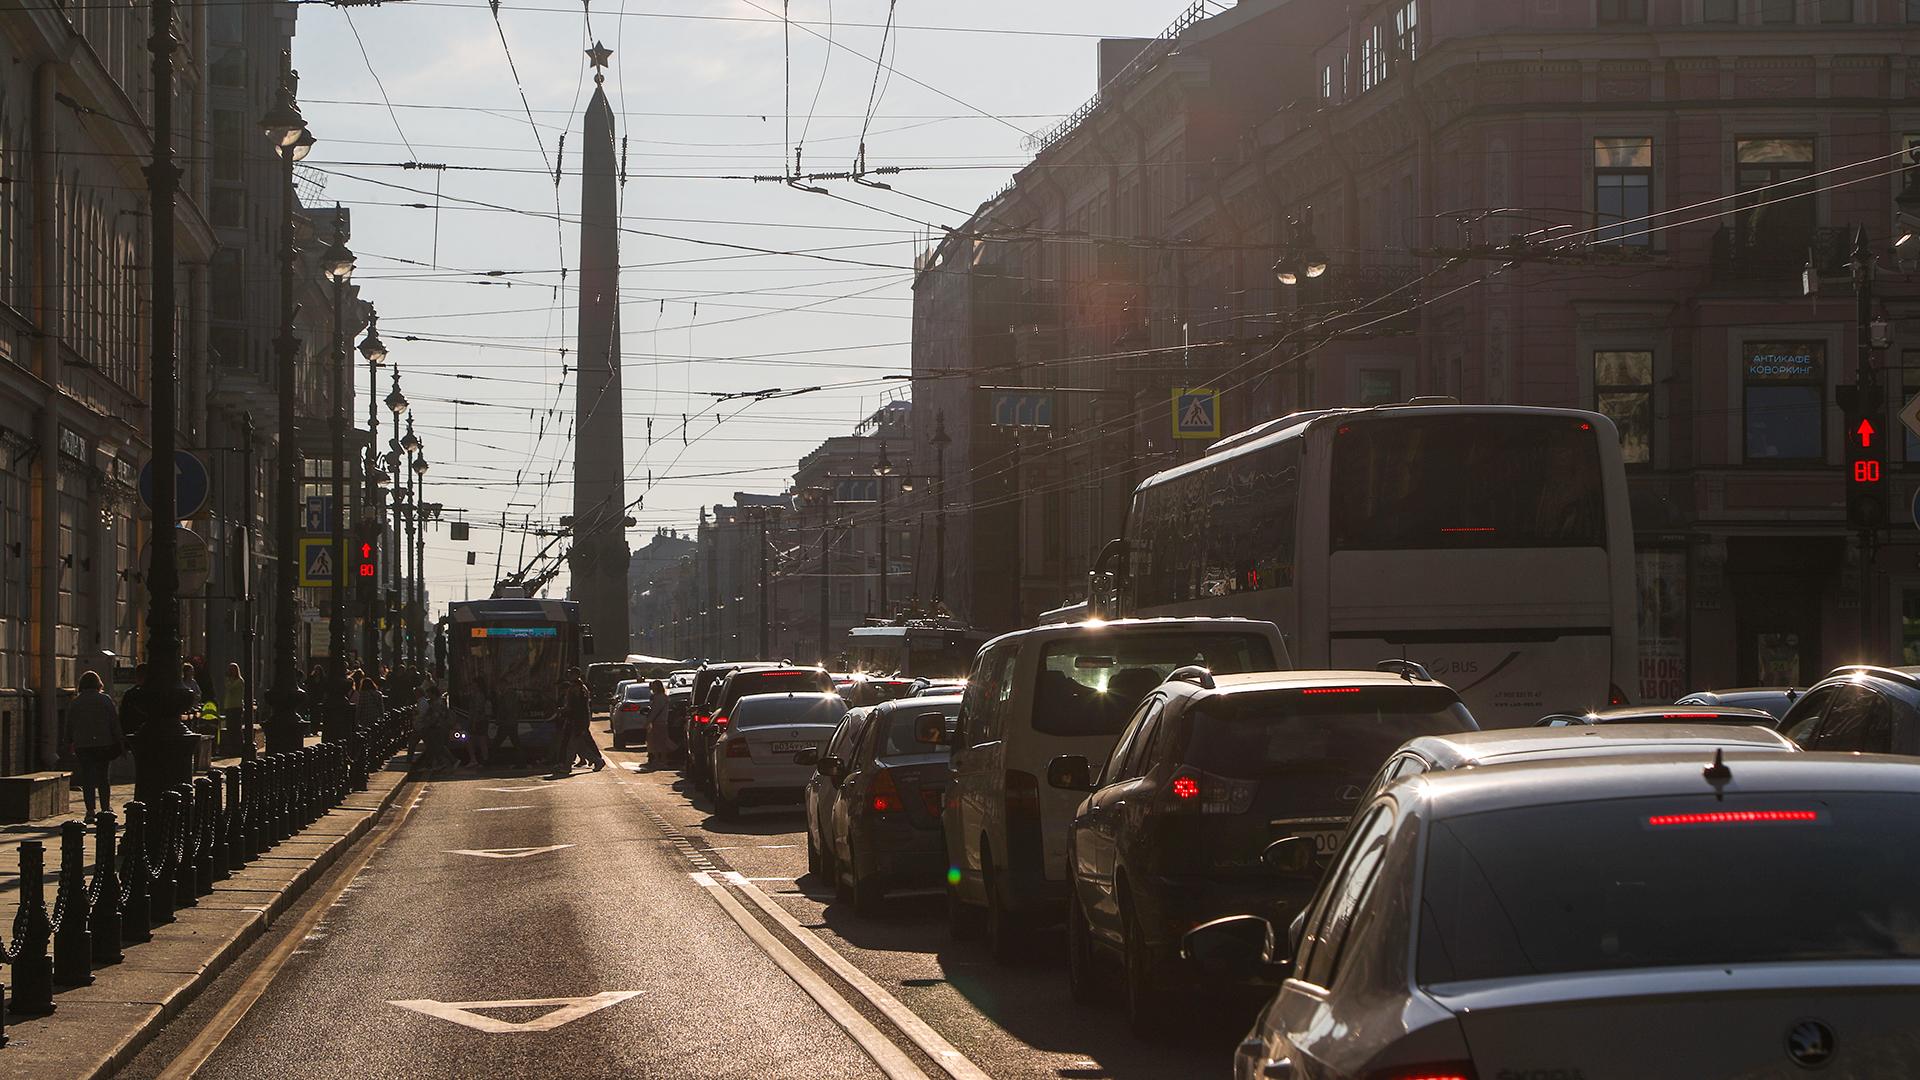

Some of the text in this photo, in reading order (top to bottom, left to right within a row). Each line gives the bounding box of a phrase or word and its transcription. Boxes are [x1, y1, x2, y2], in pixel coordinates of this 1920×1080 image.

[1753, 355, 1811, 364] АНТИКАФЕ
[1750, 366, 1813, 375] КОВОРКИНГ
[1854, 460, 1879, 482] 80
[360, 564, 374, 576] 80
[1452, 661, 1478, 673] BUS
